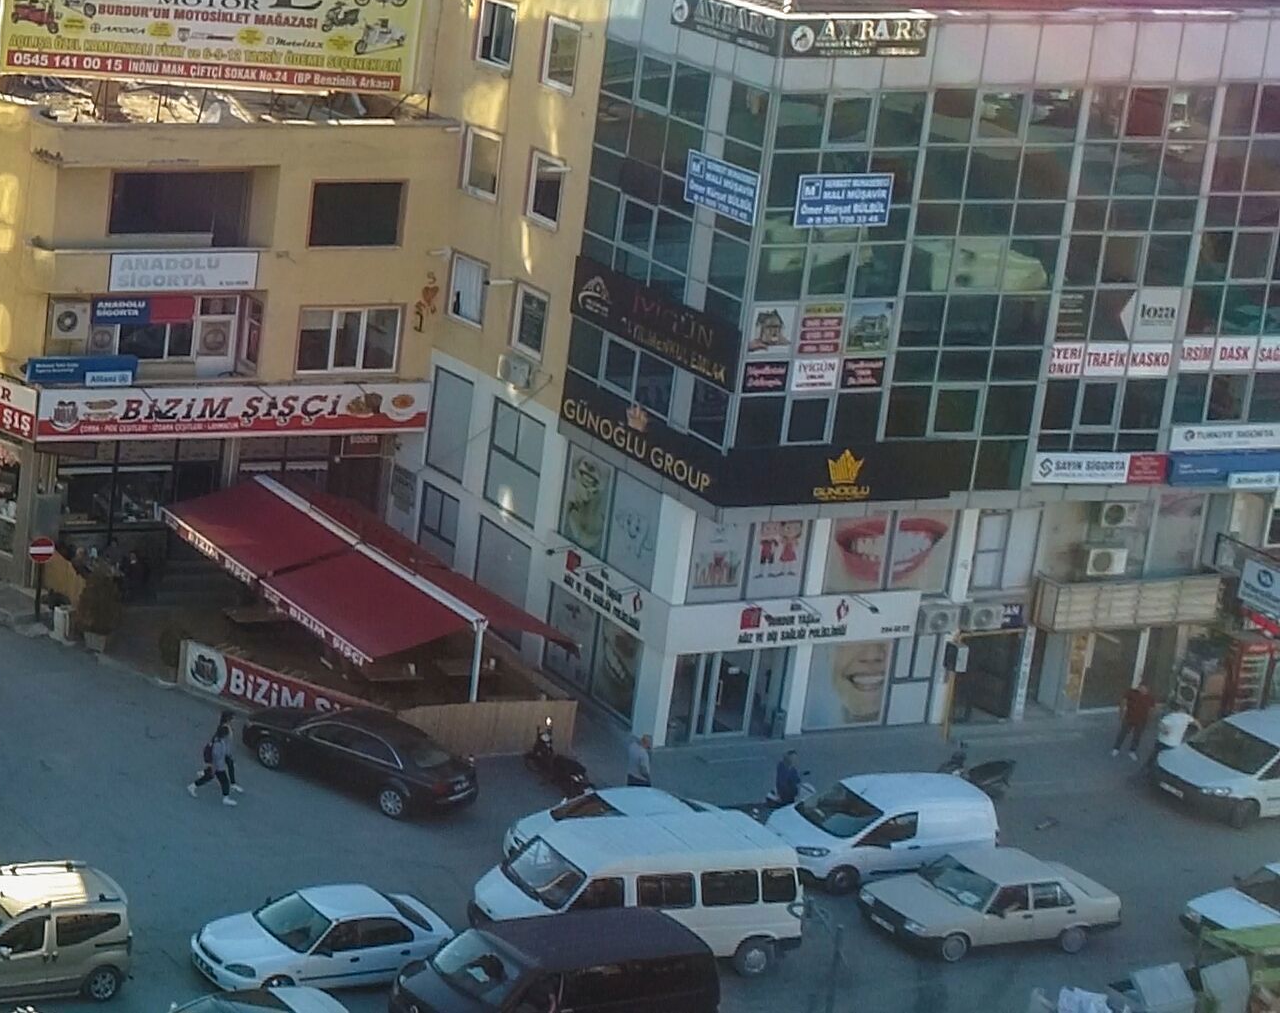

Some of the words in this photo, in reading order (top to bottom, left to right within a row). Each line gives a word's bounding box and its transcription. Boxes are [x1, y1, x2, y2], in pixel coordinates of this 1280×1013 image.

[98, 3, 170, 19] BURDUR'UN
[173, 7, 251, 24] MOTOSİKLET
[254, 13, 318, 29] MAĞAZASI
[819, 19, 928, 40] AYBARS
[13, 52, 48, 66] 0545
[54, 55, 77, 68] 141
[83, 57, 101, 69] 00
[106, 59, 123, 71] 15
[161, 62, 186, 74] MAH.
[224, 68, 257, 81] SOKAK
[313, 74, 356, 87] Benzinlik
[119, 257, 220, 272] ANADOLU
[118, 272, 206, 288] SİGORTA
[96, 300, 146, 309] ANADOLU
[96, 308, 140, 317] SİGORTA
[1087, 349, 1127, 367] TRAFİK
[1131, 351, 1170, 367] KASKO
[1219, 346, 1249, 361] DASK
[119, 397, 233, 421] BİZİM
[241, 394, 342, 425] ŞİŞÇİ
[2, 408, 31, 436] ŞİŞ
[563, 398, 646, 459] GÜNOĞLU
[650, 447, 711, 492] GROUP
[229, 666, 305, 709] BİZİM
